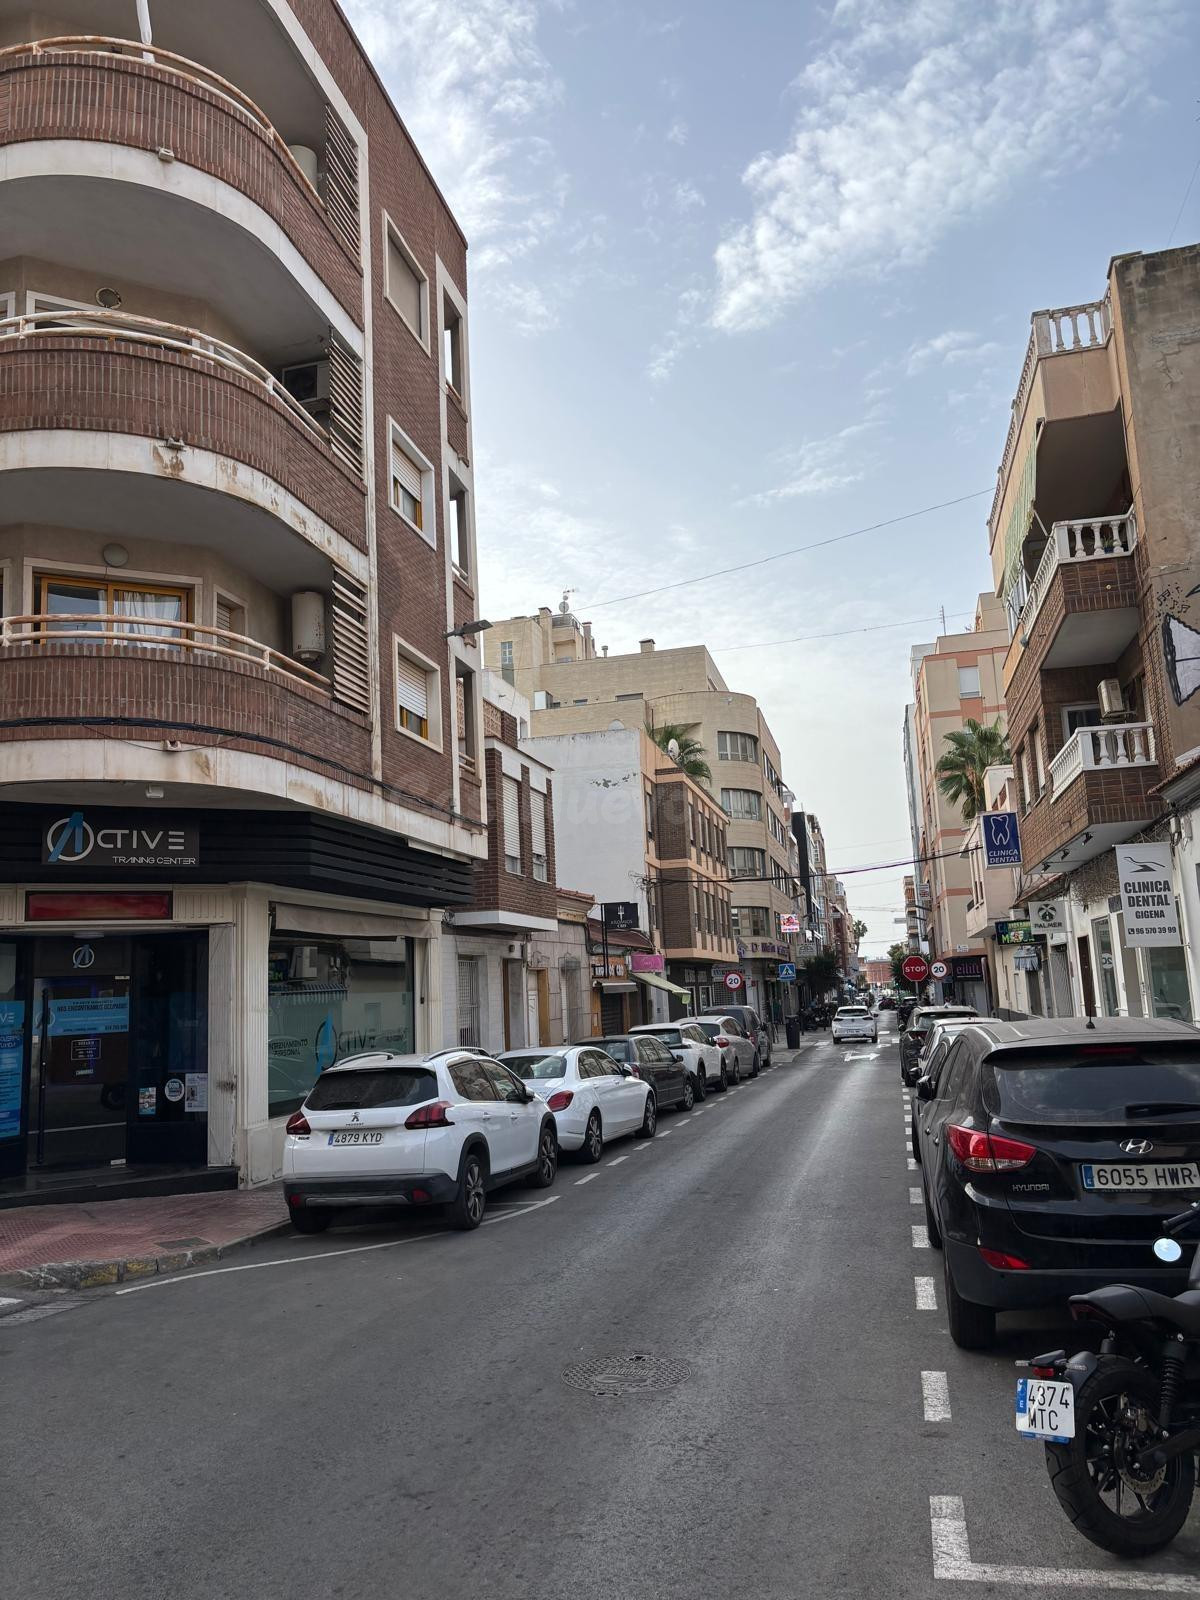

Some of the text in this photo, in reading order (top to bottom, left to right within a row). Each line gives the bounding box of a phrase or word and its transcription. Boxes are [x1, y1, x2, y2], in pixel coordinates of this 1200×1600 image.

[989, 849, 1018, 857] CLINICA
[112, 856, 196, 865] TRAINING CENTER
[990, 856, 1019, 864] DENTAL
[1124, 880, 1171, 894] CLINICA
[1128, 895, 1170, 907] DENTAL
[1135, 910, 1165, 919] GIGENA
[334, 1132, 382, 1143] 4879 KYD
[1097, 1167, 1196, 1186] 6055 HWR
[1011, 1183, 1050, 1191] HYUNDAI
[1028, 1385, 1070, 1408] 4374
[1028, 1408, 1058, 1430] MTC
